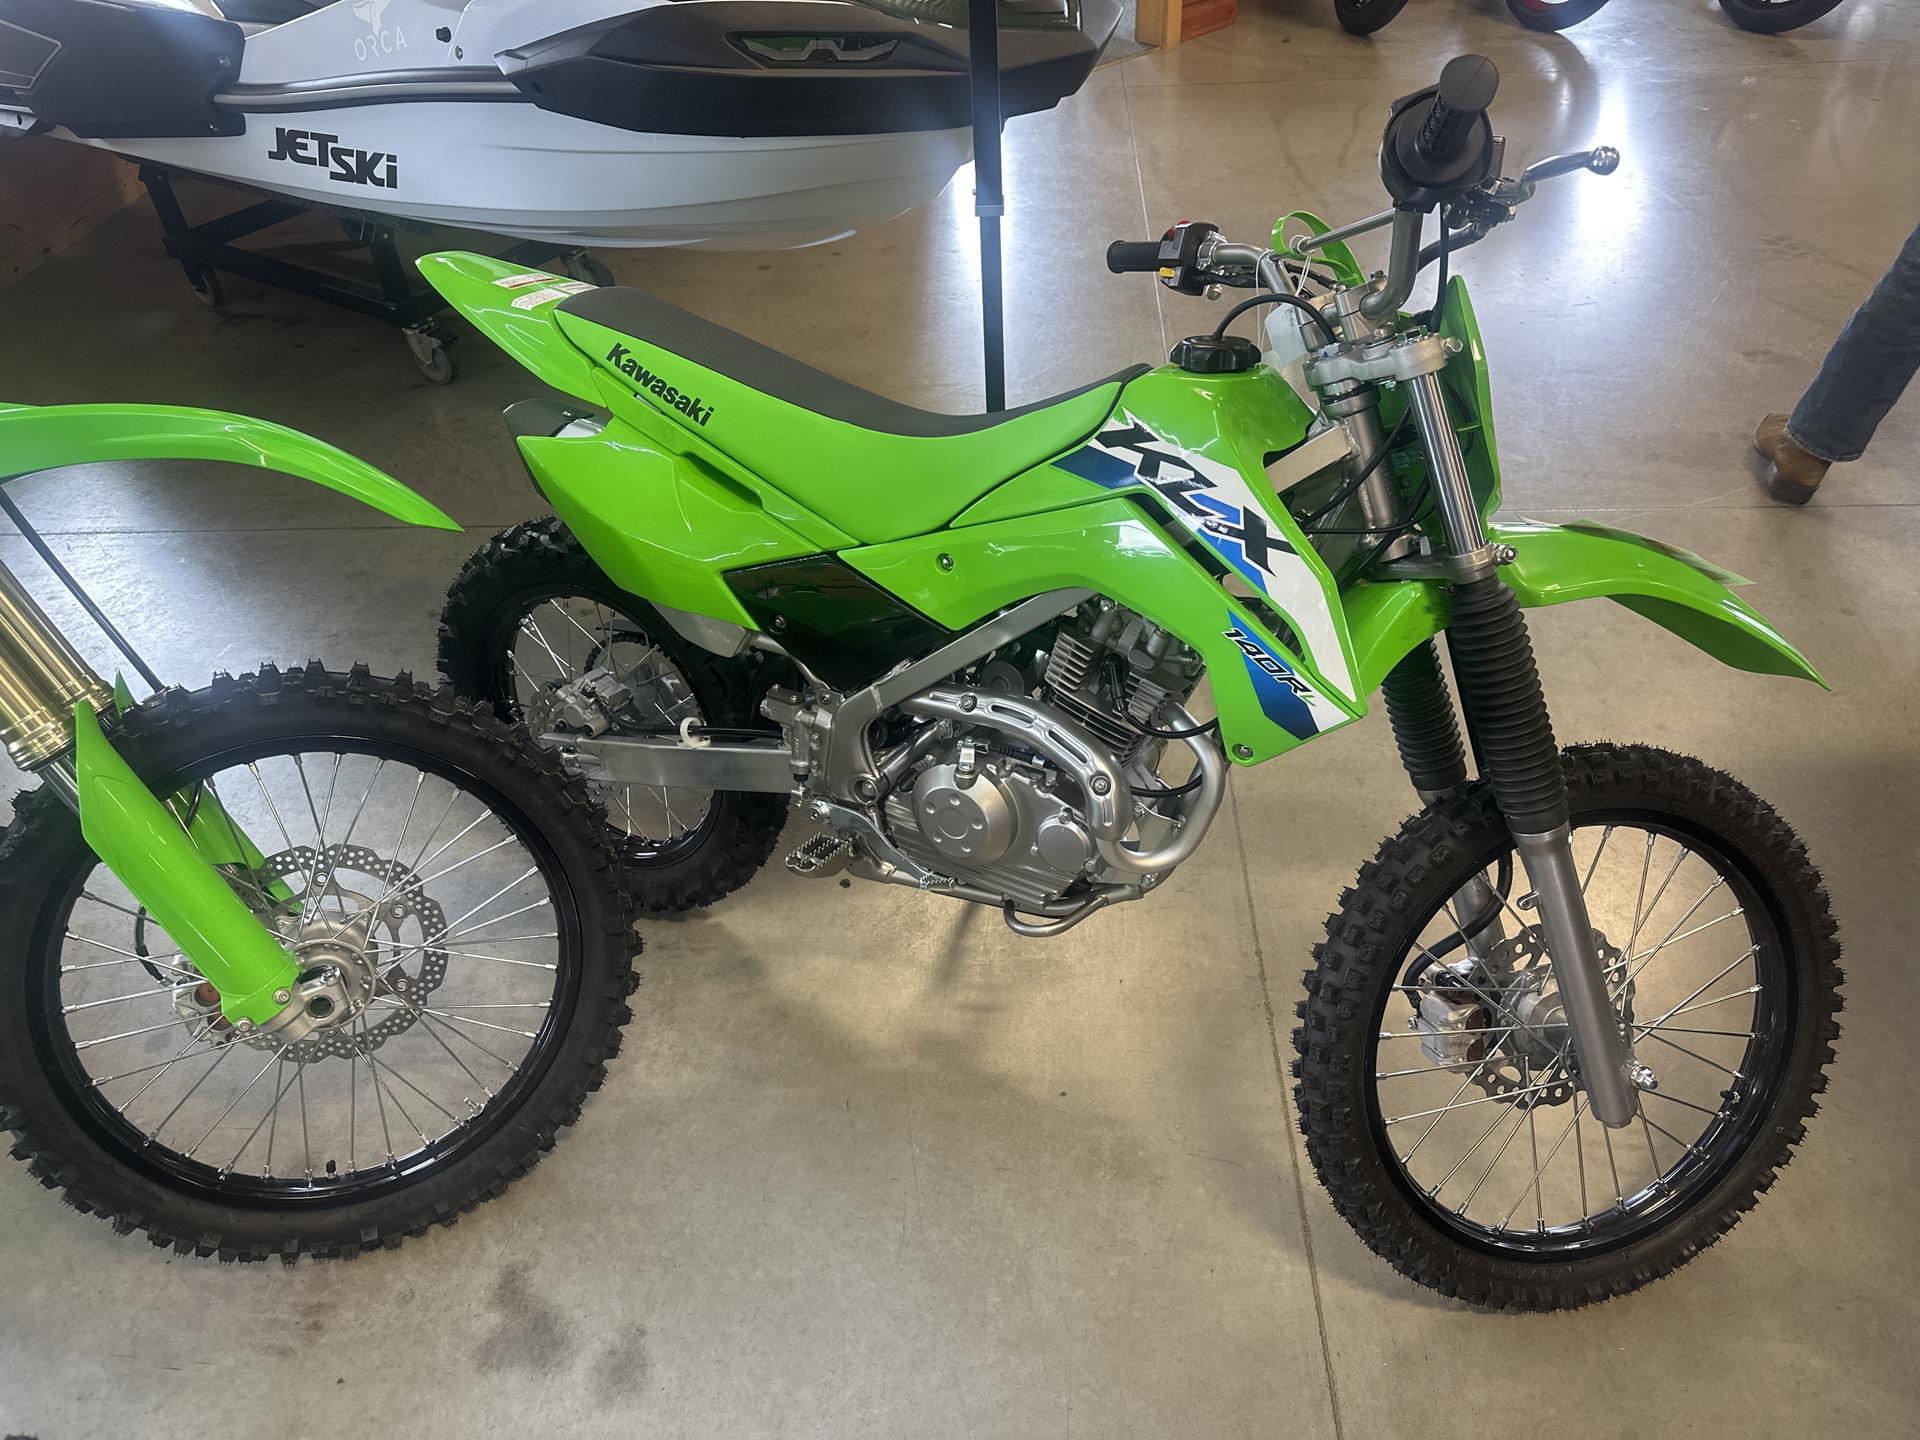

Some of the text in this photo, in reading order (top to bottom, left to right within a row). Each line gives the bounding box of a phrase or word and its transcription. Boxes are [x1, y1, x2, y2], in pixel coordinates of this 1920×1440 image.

[354, 26, 408, 61] ORCA
[606, 342, 715, 427] Kawasaki
[1094, 418, 1299, 578] KLX
